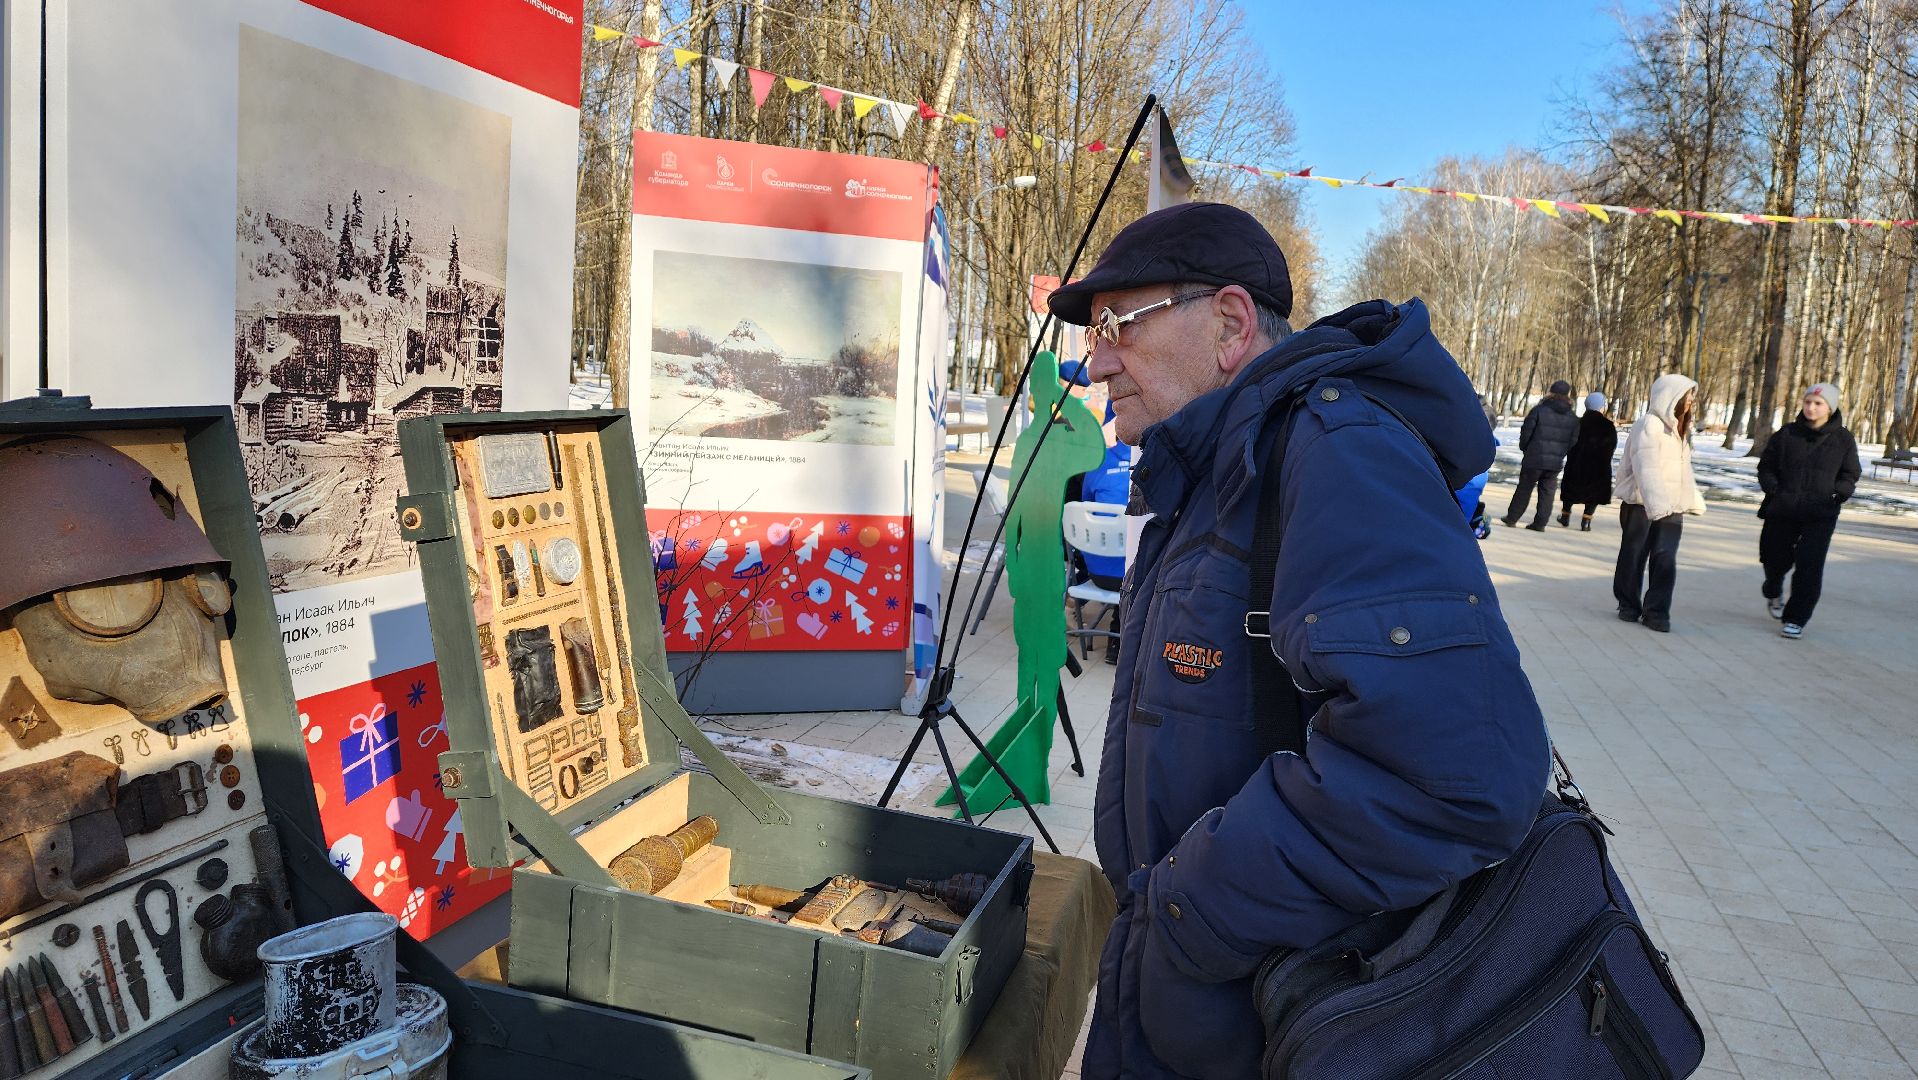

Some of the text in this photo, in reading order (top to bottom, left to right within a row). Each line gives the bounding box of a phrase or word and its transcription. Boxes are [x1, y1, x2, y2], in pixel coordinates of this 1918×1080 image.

[523, 0, 574, 24] НЕЧНОГОРЬЯ
[648, 176, 689, 187] губернатора
[295, 603, 334, 621] Исаак
[338, 597, 375, 611] Ильич
[325, 617, 355, 635] 1884
[1162, 642, 1223, 667] PLASTIC
[1174, 665, 1206, 678] TRENDS
